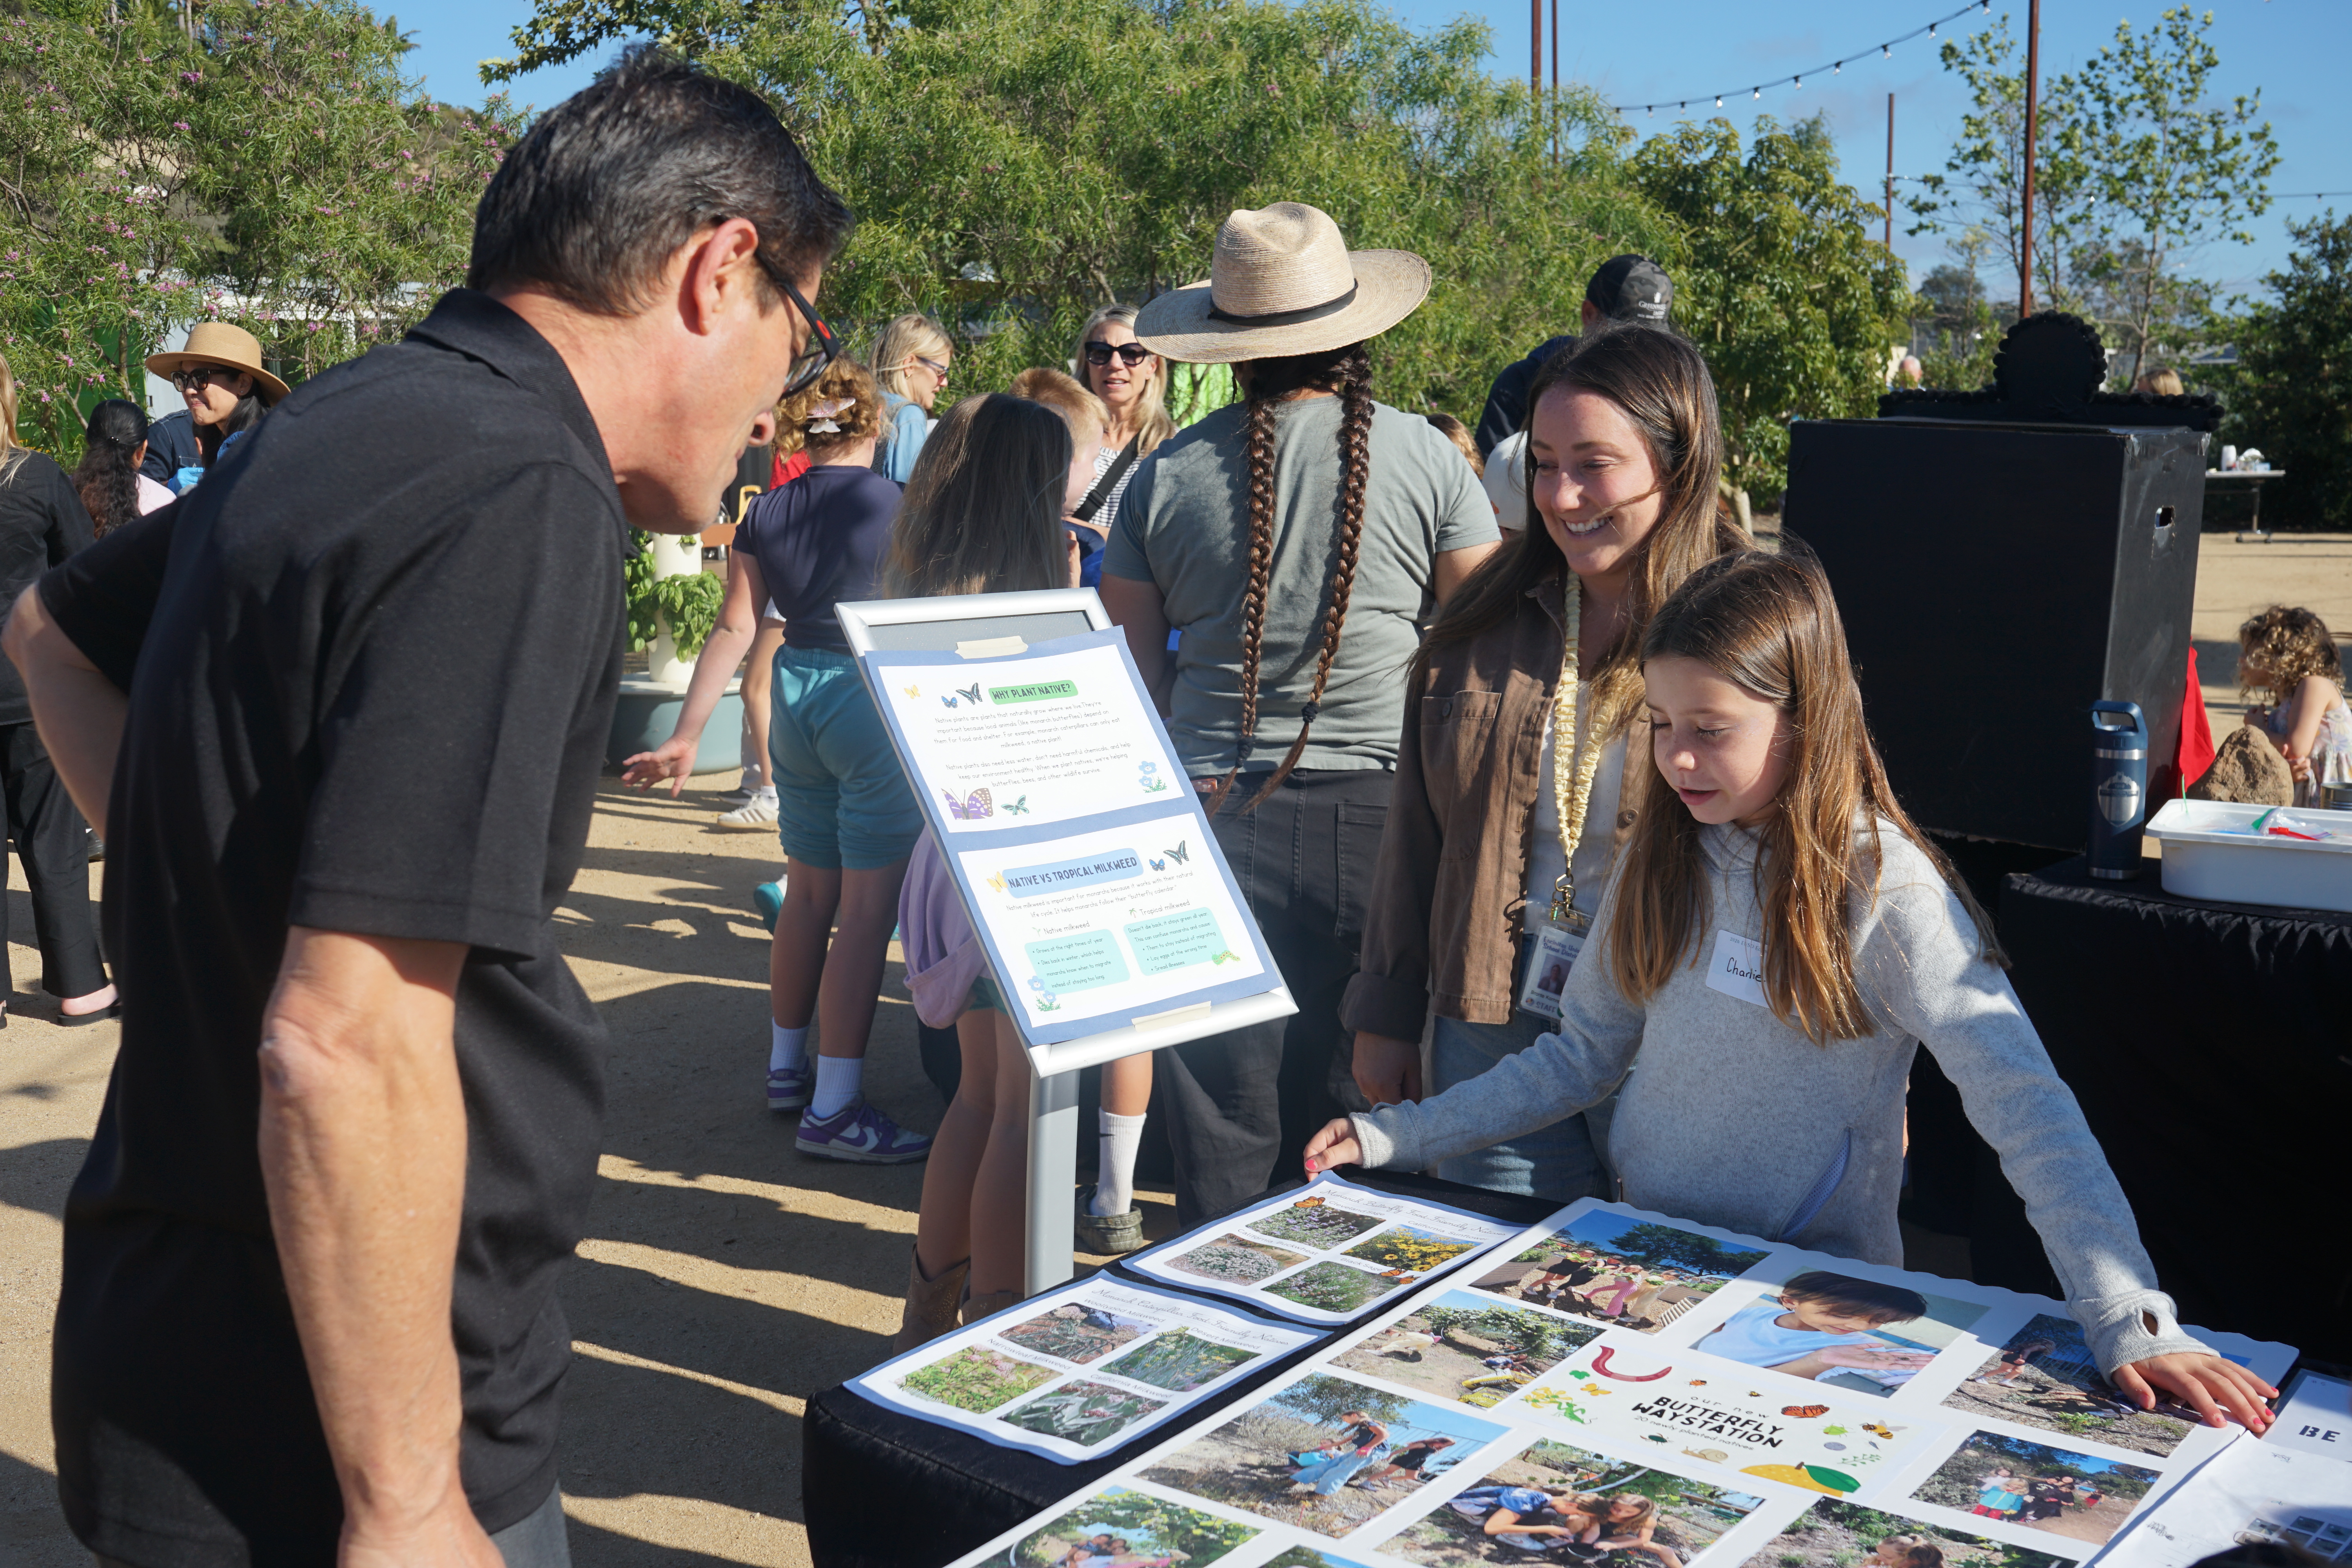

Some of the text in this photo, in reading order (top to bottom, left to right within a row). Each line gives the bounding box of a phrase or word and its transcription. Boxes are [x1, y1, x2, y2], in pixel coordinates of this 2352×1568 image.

[991, 683, 1071, 700] WHY PLANT NATIVE?
[936, 726, 962, 735] important
[1051, 712, 1082, 722] butterflies)
[1083, 710, 1102, 718] depend
[1060, 722, 1089, 731] caterpillars
[1000, 740, 1026, 748] milkweed,
[1084, 745, 1109, 754] chemicals,
[982, 769, 1013, 778] environment
[1060, 760, 1073, 769] plant
[1008, 857, 1137, 888] NATIVE VS TROPICAL MILKWEED
[1023, 900, 1045, 908] milkweed
[1051, 895, 1075, 904] important
[1086, 888, 1110, 898] monarchs
[1176, 870, 1193, 879] natural
[1074, 901, 1098, 910] monarchs
[1127, 890, 1153, 899] "butterfly
[1138, 899, 1190, 915] Tropical milkweed
[1063, 920, 1090, 931] milkweed
[1174, 936, 1190, 944] instead
[1320, 1190, 1364, 1203] Monarch
[1363, 1201, 1404, 1214] Butterfly
[1470, 1227, 1506, 1236] Natives
[1329, 1201, 1366, 1212] Cleveland
[1408, 1220, 1489, 1241] California Sunflower
[1238, 1229, 1319, 1255] California Buckwheat
[1084, 1298, 1166, 1322] Woollypod Milkweed
[1092, 1289, 1138, 1304] Monarch
[1138, 1300, 1184, 1316] Caterpillar
[1252, 1333, 1289, 1345] Natives
[1191, 1327, 1261, 1349] Desert Milkweed
[987, 1338, 1073, 1370] Narrowleaf Milkweed
[1091, 1374, 1174, 1397] California Milkweed
[1653, 1396, 1784, 1435] BUTTERFLY
[1690, 1396, 1769, 1419] our new
[1631, 1403, 1784, 1448] WAYSTATION
[1650, 1420, 1678, 1431] newly
[1679, 1428, 1718, 1441] planted
[1719, 1438, 1754, 1451] natives
[2299, 1425, 2341, 1443] BE
